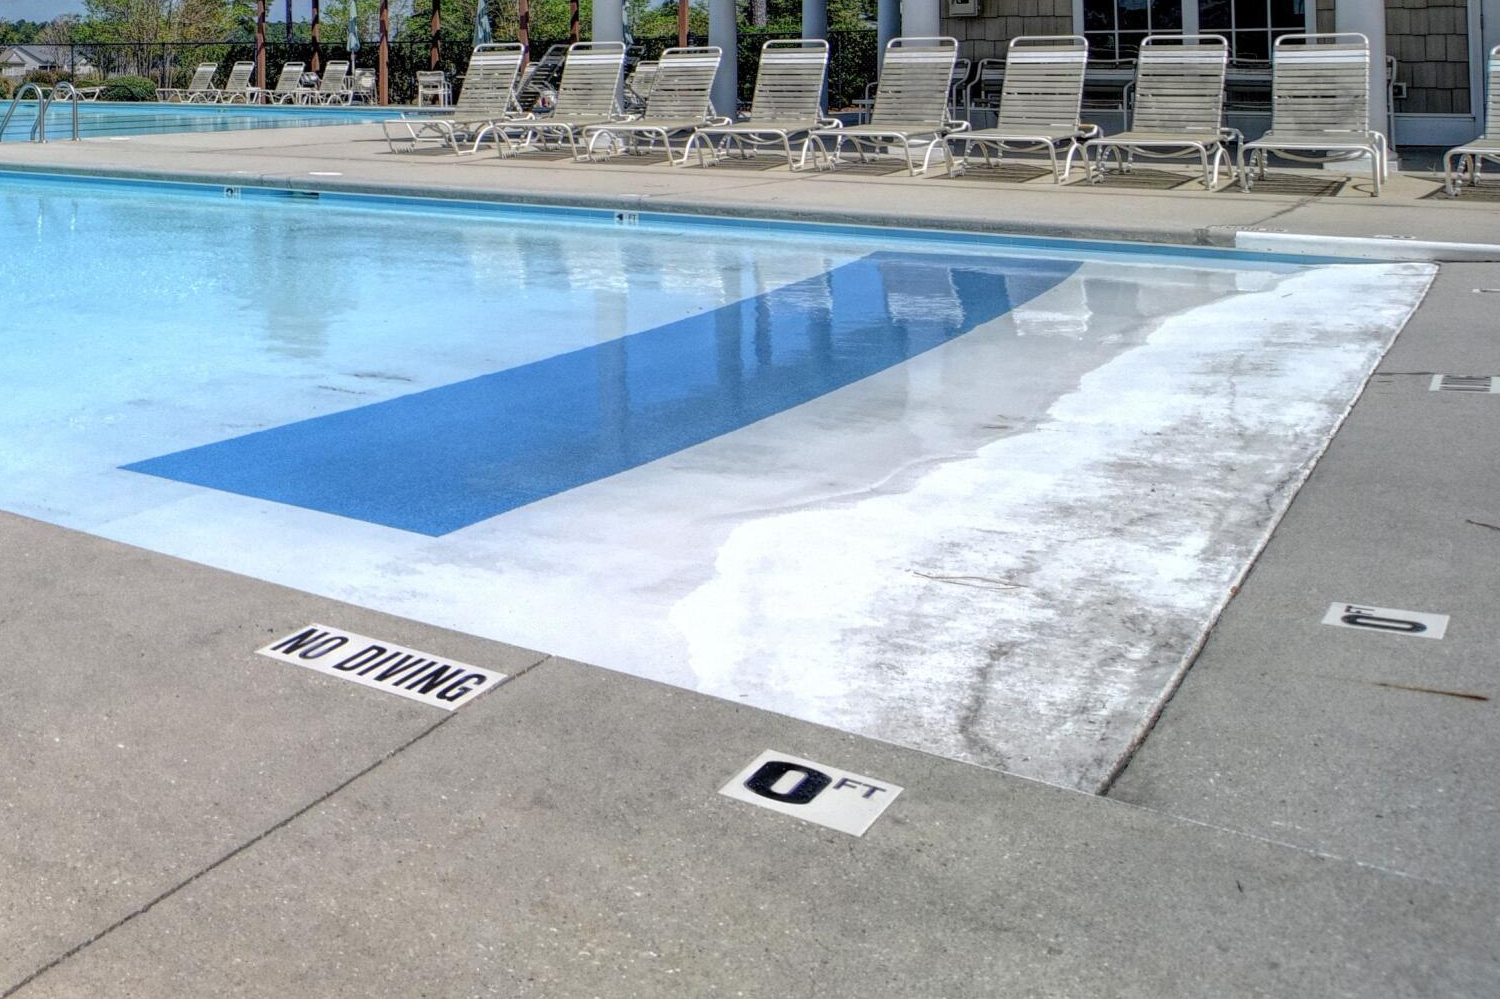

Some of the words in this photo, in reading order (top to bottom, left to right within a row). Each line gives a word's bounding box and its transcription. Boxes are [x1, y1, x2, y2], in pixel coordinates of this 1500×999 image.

[270, 628, 349, 660] NO
[332, 644, 488, 702] DIVING
[743, 760, 833, 805] 0
[832, 777, 888, 800] FT
